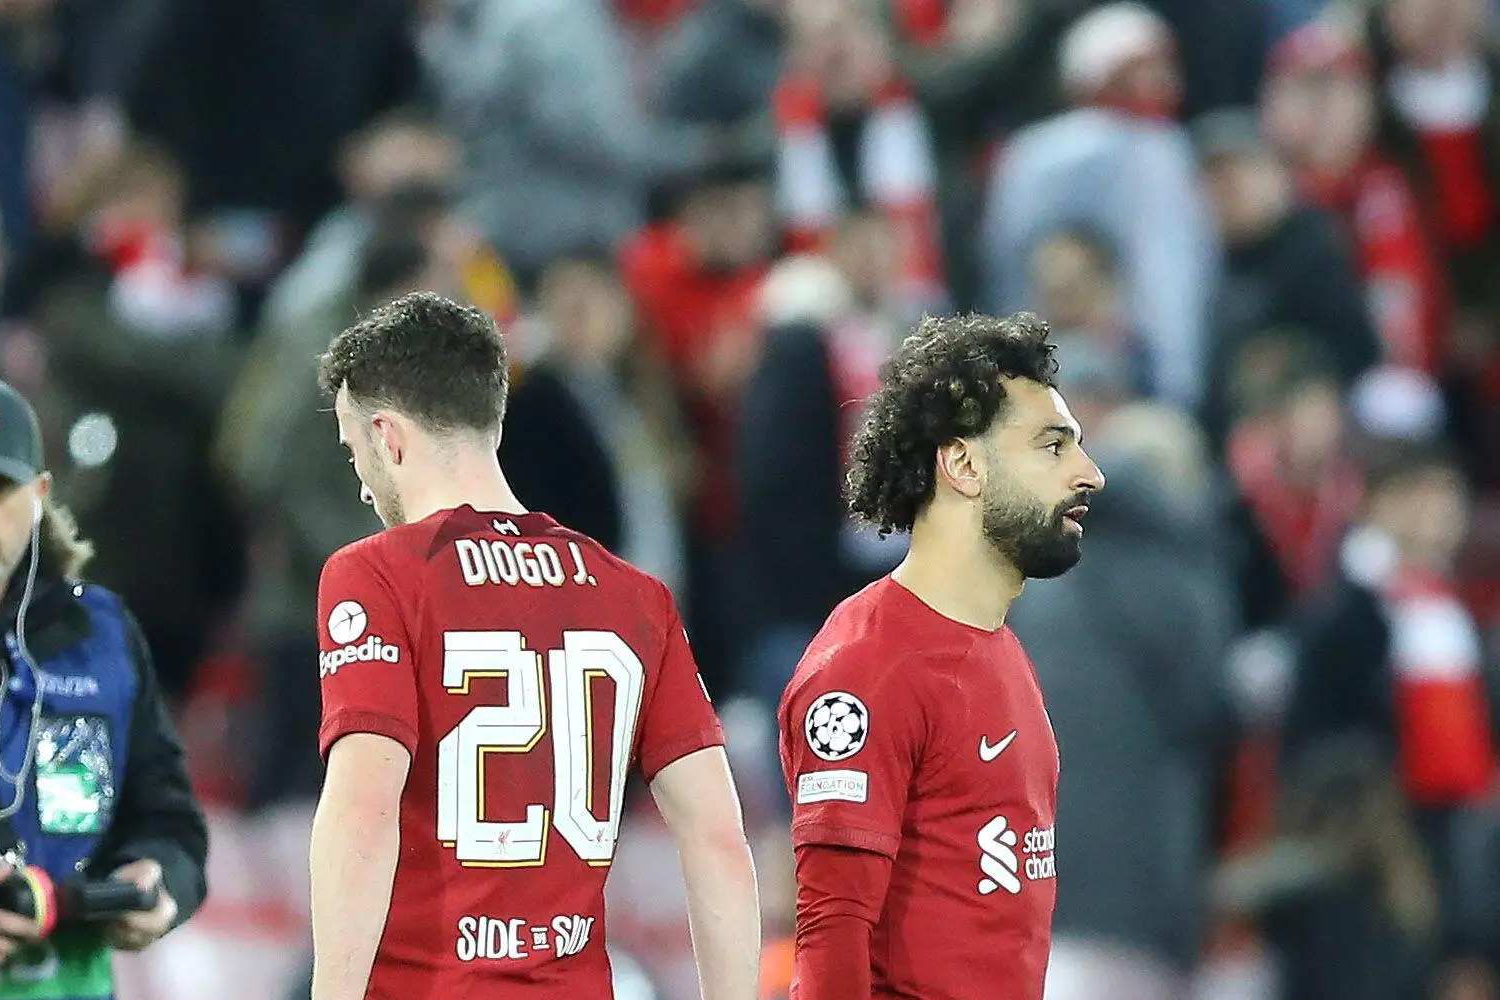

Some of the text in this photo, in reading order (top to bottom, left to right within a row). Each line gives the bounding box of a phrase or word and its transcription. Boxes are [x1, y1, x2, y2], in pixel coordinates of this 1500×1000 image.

[454, 539, 597, 586] DIOGO J.
[437, 630, 645, 867] 20
[457, 915, 529, 961] SIDE
